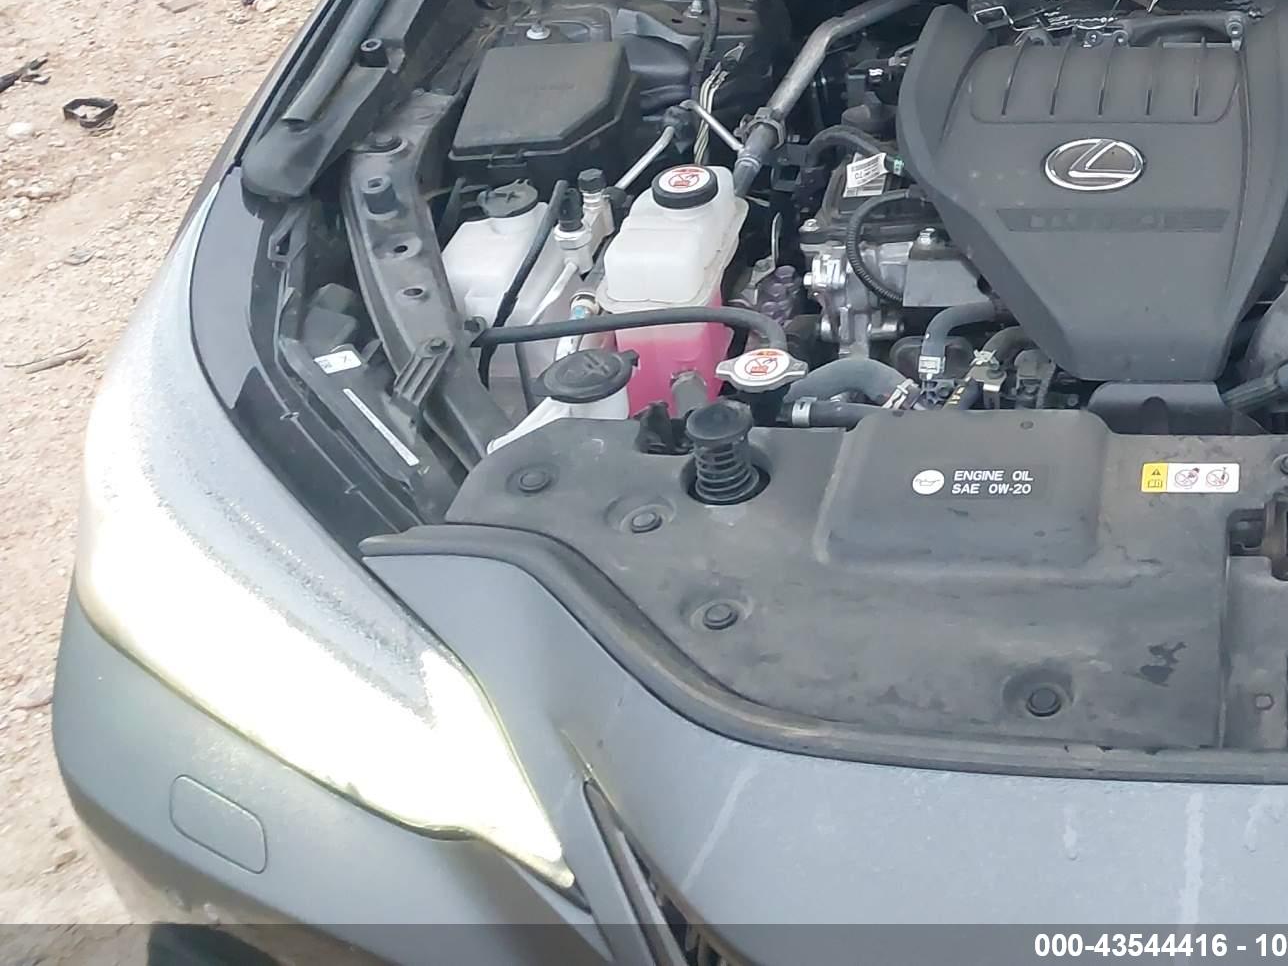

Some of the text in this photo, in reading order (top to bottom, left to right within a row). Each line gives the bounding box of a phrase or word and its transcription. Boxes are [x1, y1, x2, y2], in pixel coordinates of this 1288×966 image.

[953, 470, 1034, 481] ENGINE OIL
[951, 483, 1032, 494] SAE 0W-20
